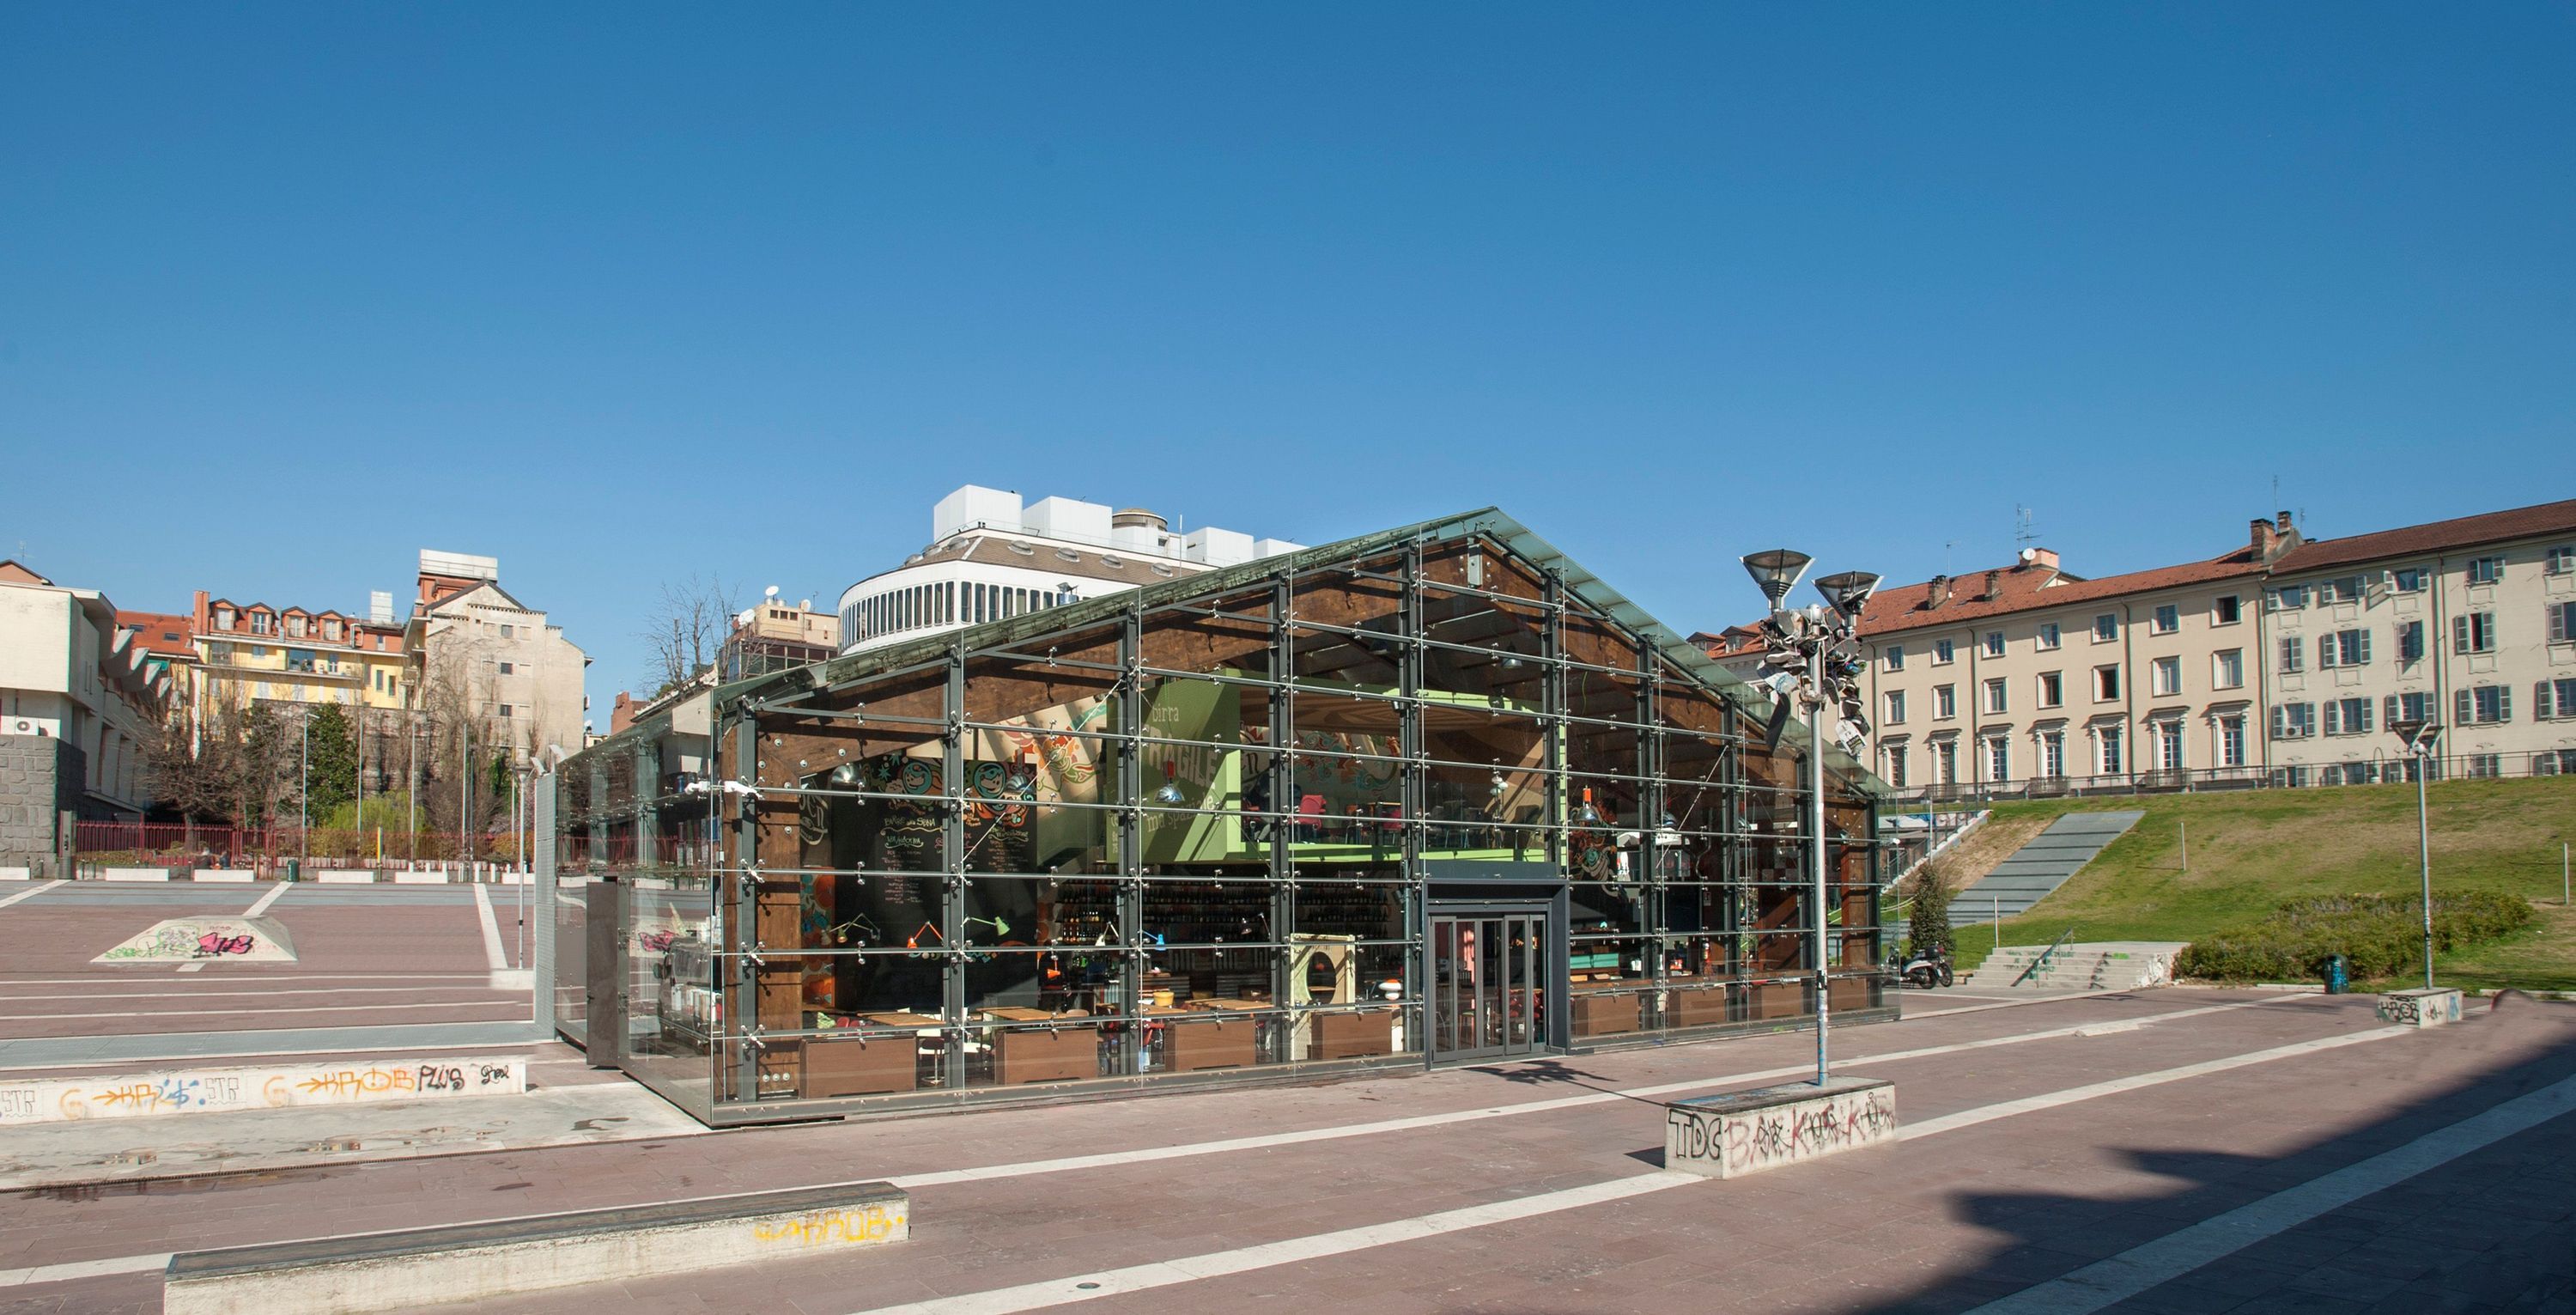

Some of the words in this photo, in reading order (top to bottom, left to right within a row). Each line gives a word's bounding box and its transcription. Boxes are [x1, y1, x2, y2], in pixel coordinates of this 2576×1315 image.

[1151, 703, 1180, 722] birra
[1142, 723, 1218, 788] RAGILE
[1146, 812, 1166, 832] ma
[418, 1065, 465, 1091] PLUS
[1668, 1108, 1721, 1160] TDC
